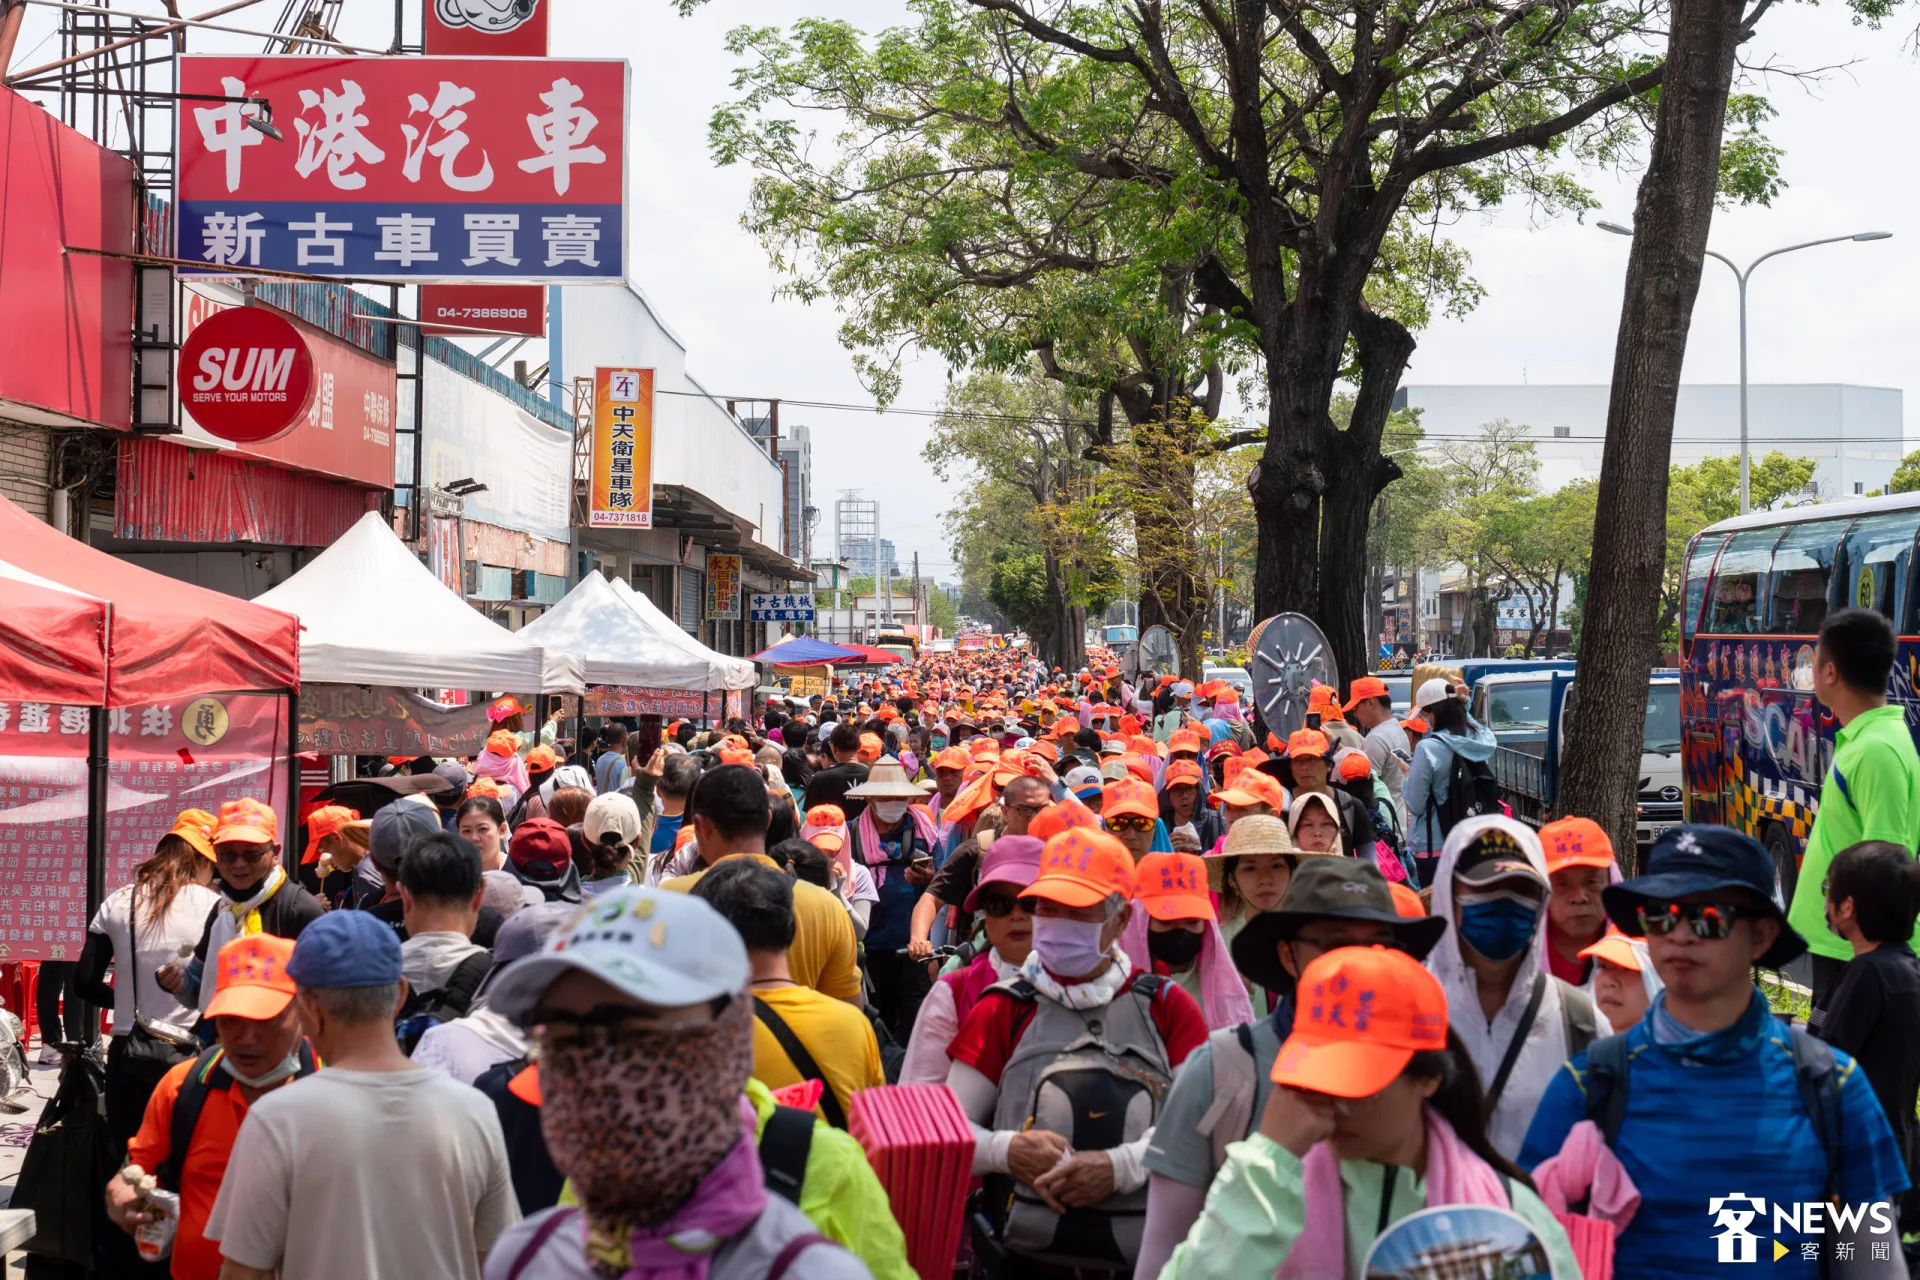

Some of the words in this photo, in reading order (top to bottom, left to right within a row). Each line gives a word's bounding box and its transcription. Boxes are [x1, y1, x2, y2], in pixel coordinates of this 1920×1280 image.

[194, 76, 606, 195] 中港汽車
[201, 212, 602, 267] 新古車買賣
[437, 307, 527, 319] 04-7386908
[193, 347, 296, 391] SUM
[193, 392, 222, 403] SERVE
[224, 392, 247, 403] YOUR
[250, 392, 287, 403] MOTORS
[609, 405, 635, 508] 中天衛星車隊
[594, 512, 647, 523] 04-7371818
[717, 571, 730, 611] 百貨批發
[753, 595, 813, 609] 中古機械
